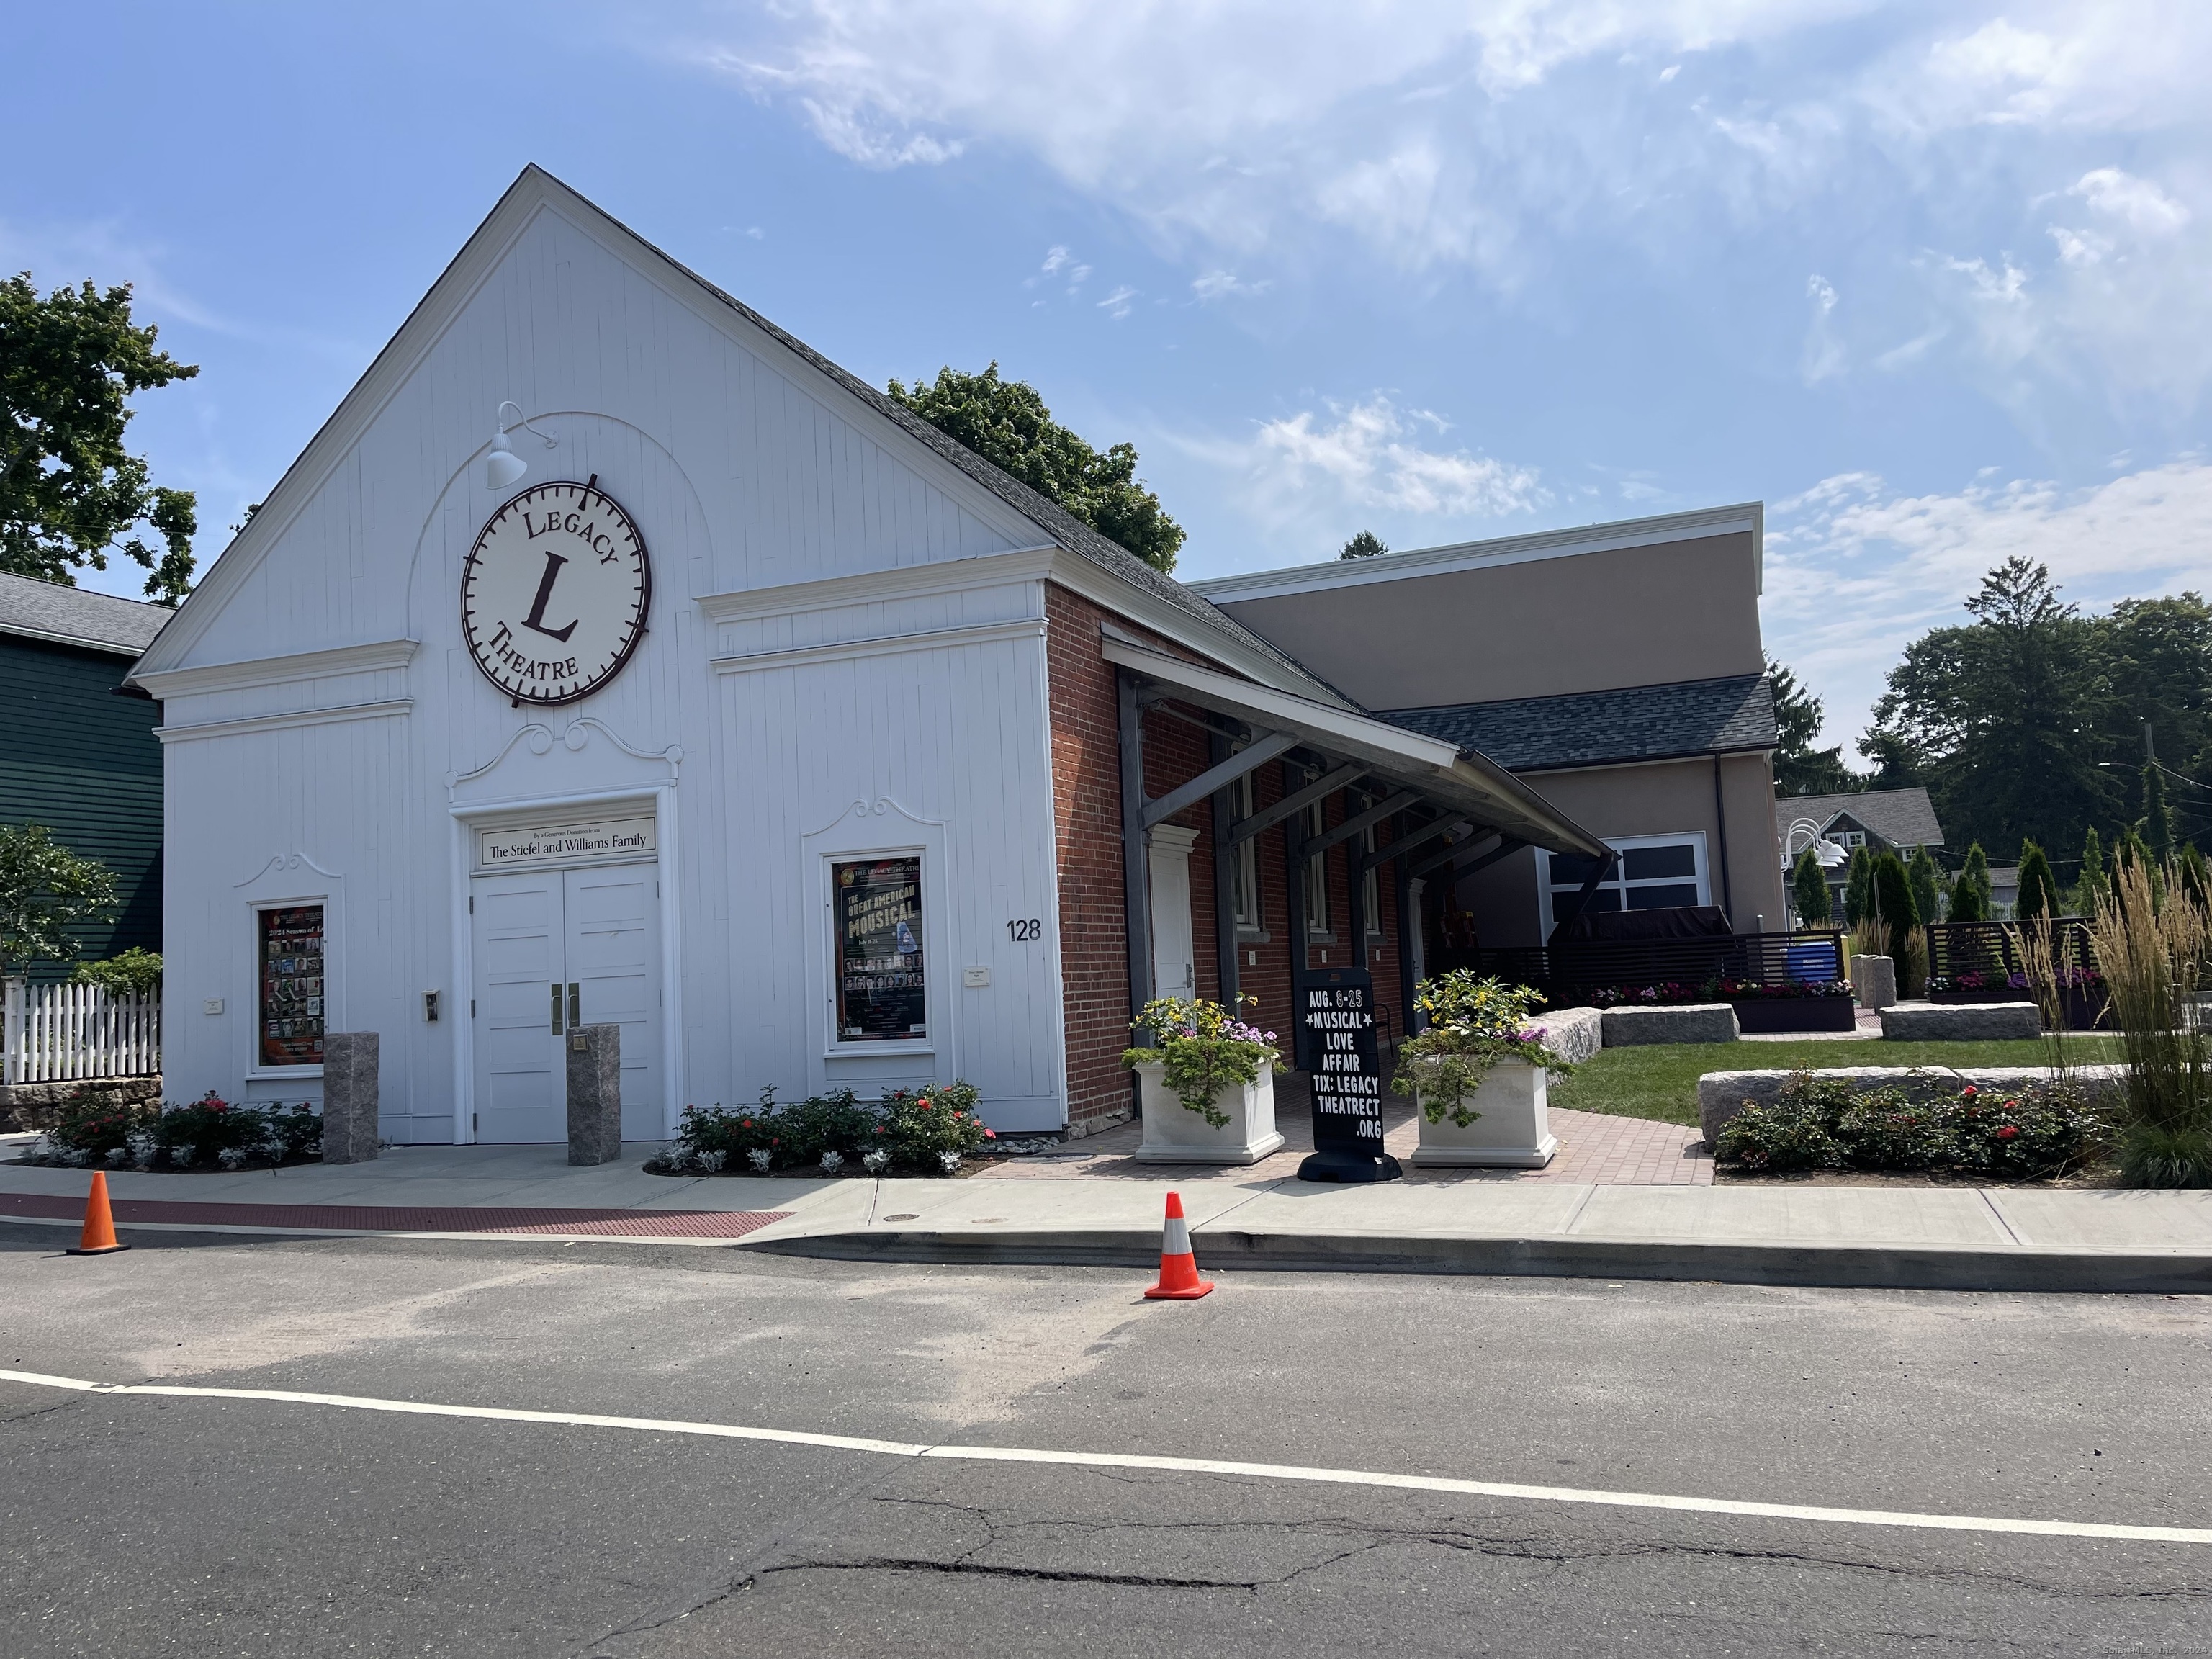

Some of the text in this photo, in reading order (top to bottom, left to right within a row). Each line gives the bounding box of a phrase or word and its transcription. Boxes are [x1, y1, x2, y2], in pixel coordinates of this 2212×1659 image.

[522, 511, 619, 565] LEGACY
[521, 551, 579, 643] L
[488, 621, 579, 680] THEATRE
[490, 833, 647, 858] The Stiefel and Williams Family
[848, 894, 858, 904] THE
[848, 884, 915, 917] GREAT AMERICAN
[848, 901, 915, 938] MOUSICAL
[1007, 919, 1041, 942] 128
[1309, 989, 1363, 1008] AUG. 8-25
[1313, 1011, 1363, 1029] MUSICAL
[1326, 1033, 1354, 1051] LOVE
[1323, 1053, 1360, 1072] AFFAIR
[1313, 1074, 1379, 1094] TIX: LEGACY
[1318, 1095, 1380, 1116] THEATRECT
[1356, 1120, 1382, 1138] .ORG
